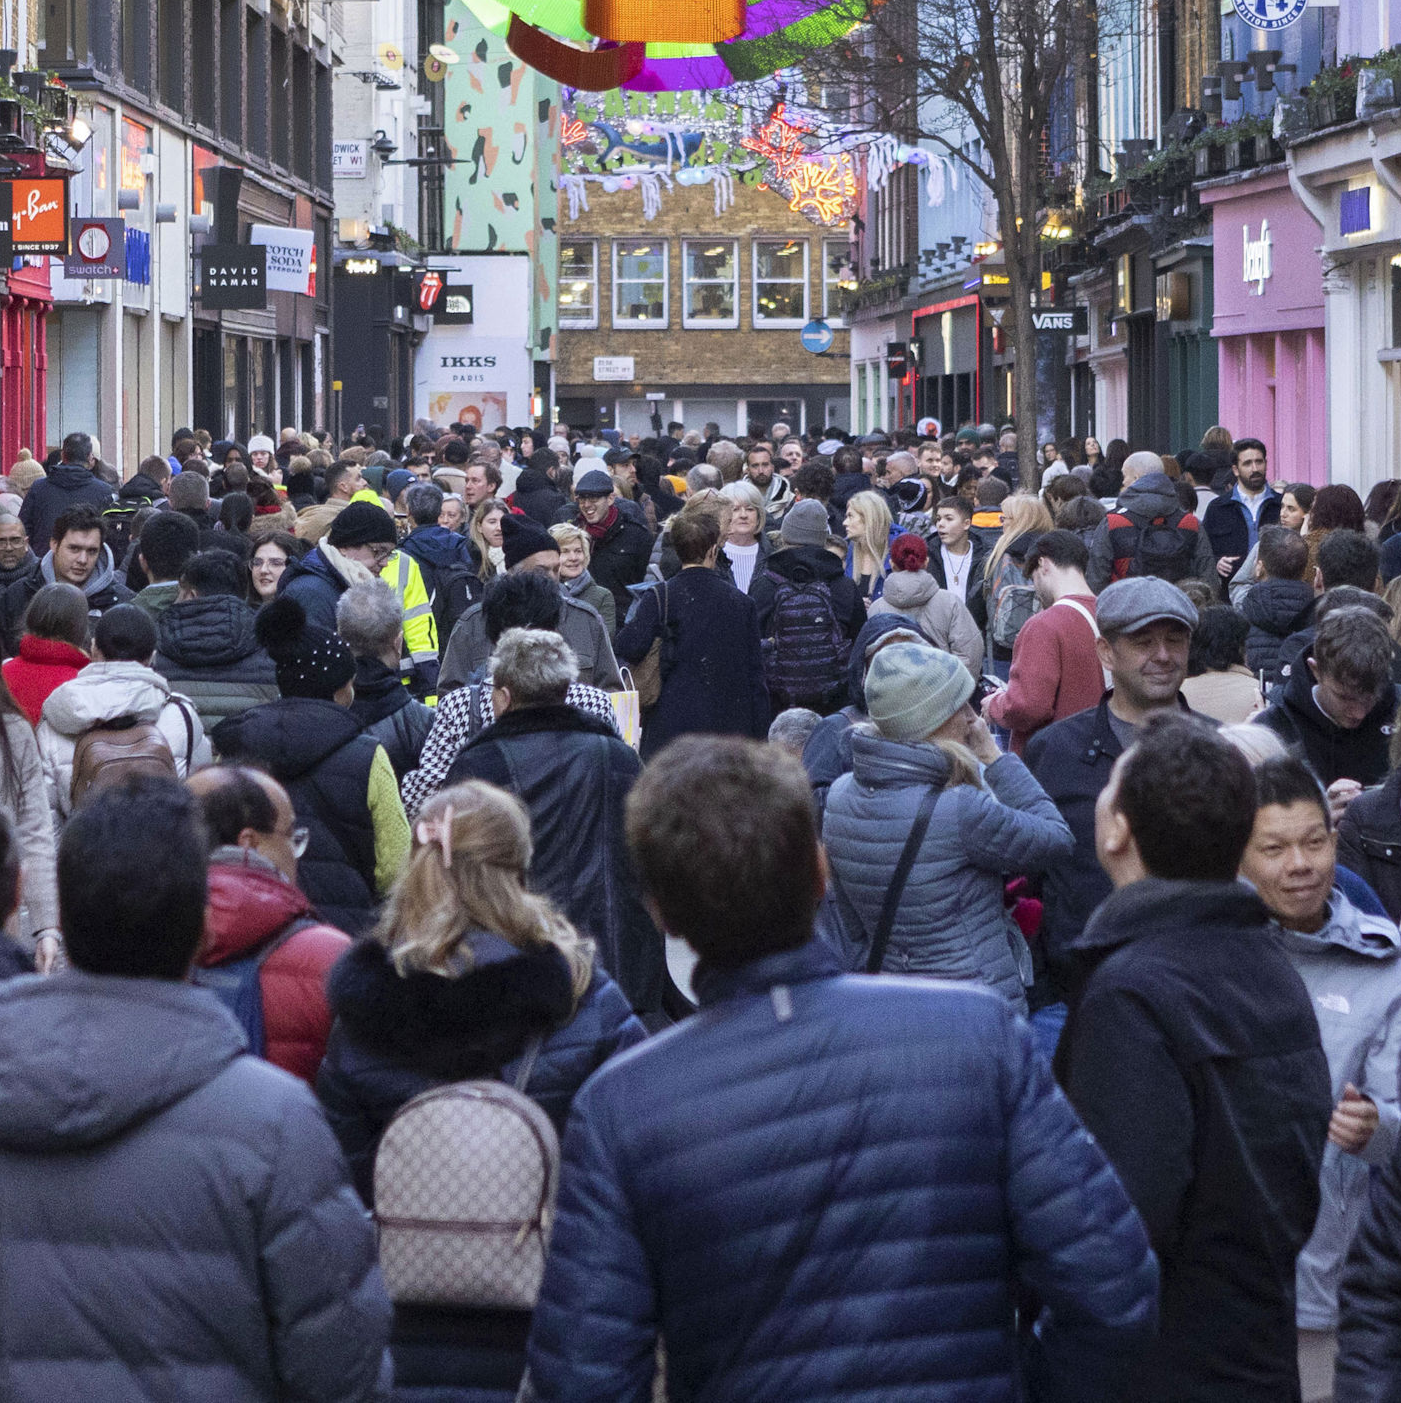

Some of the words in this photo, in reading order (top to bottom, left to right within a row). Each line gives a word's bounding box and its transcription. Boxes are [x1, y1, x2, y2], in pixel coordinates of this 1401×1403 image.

[1271, 9, 1299, 28] SINCE
[350, 156, 363, 166] W1
[266, 245, 304, 258] COTCH
[270, 256, 302, 268] SODA
[68, 264, 112, 275] swatch
[209, 267, 258, 276] DAVID
[267, 266, 303, 274] STERDAM
[209, 278, 258, 287] NAMAN
[1032, 312, 1074, 330] VANS
[440, 356, 497, 368] IKKS
[452, 374, 485, 382] PARIS
